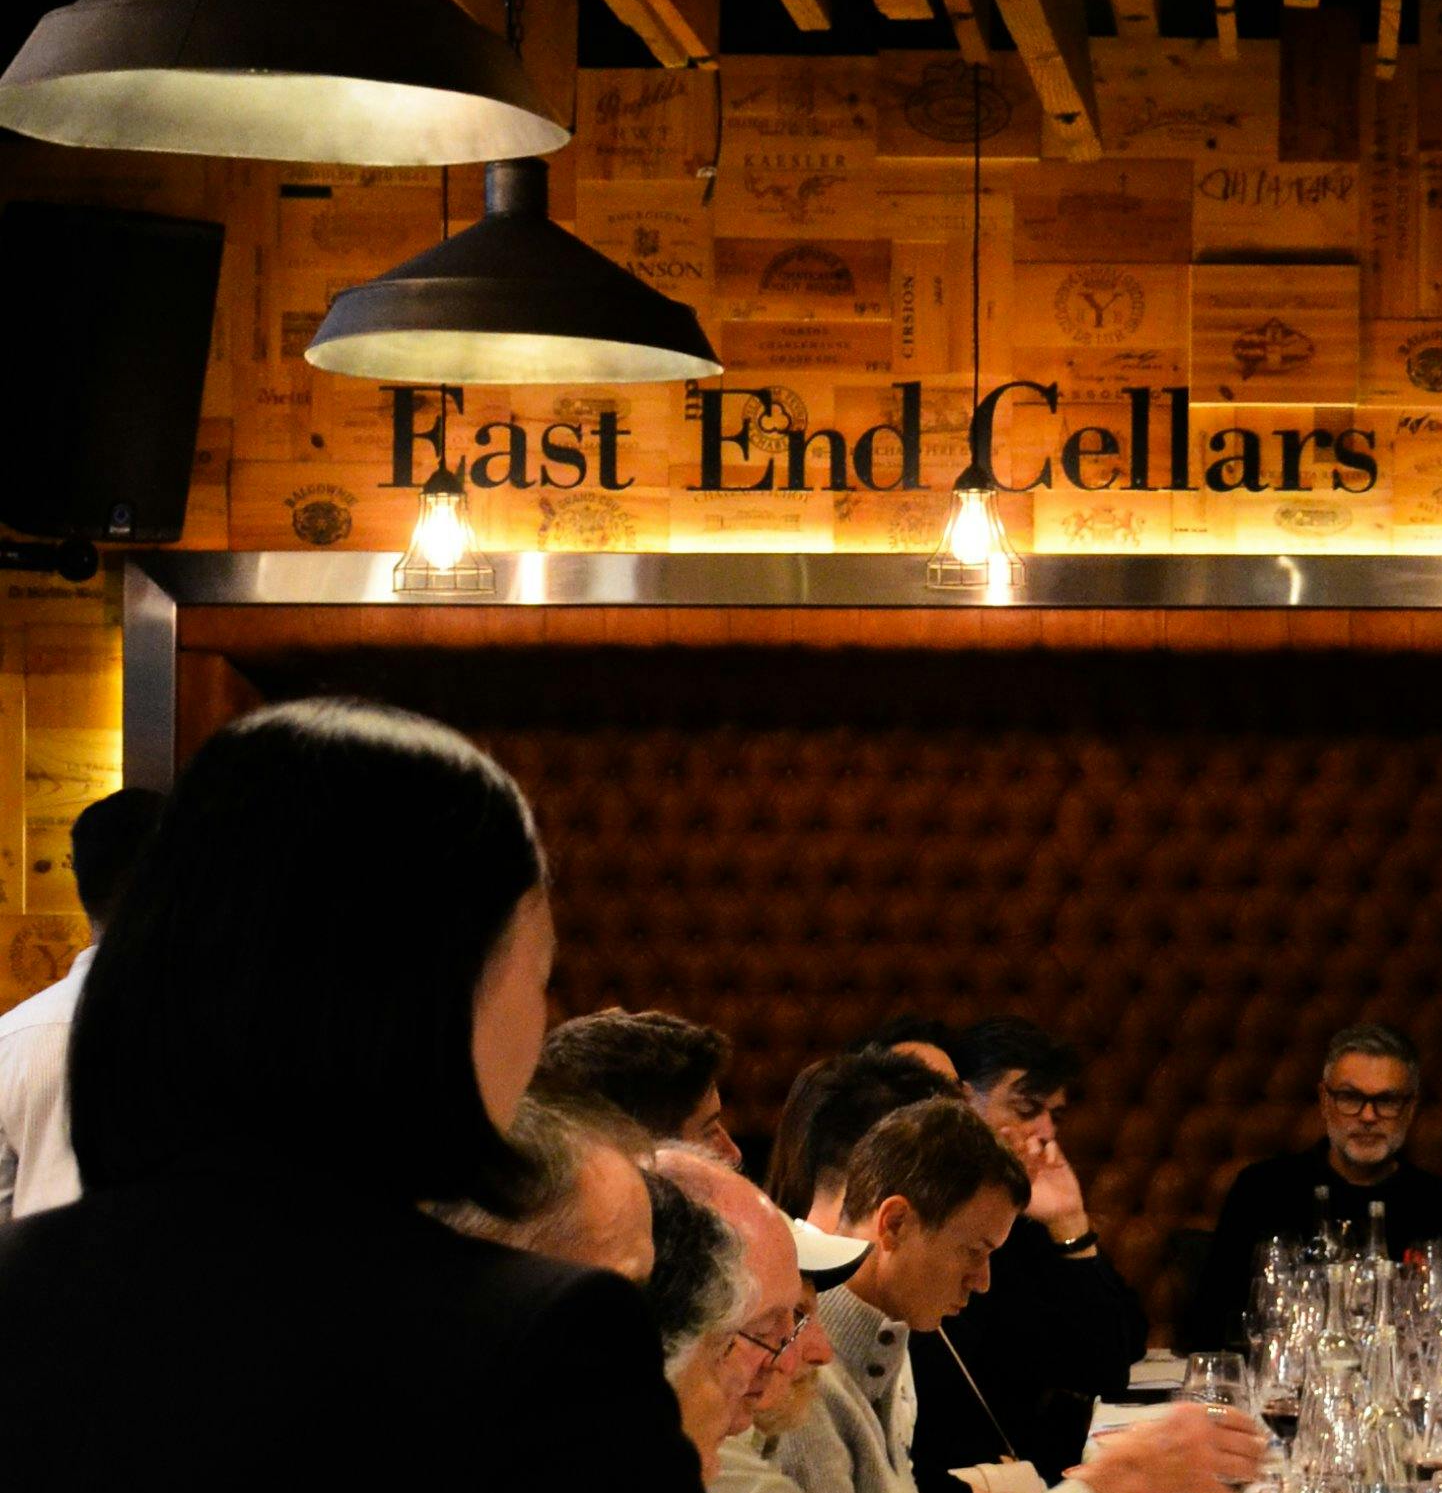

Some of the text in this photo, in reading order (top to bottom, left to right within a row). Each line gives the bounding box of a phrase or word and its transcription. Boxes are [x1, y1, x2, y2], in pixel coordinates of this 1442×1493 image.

[744, 154, 847, 168] KAESLER
[627, 260, 703, 278] ANSON
[902, 275, 915, 359] CIRSION
[378, 380, 1378, 493] East End Cellars
[283, 483, 358, 508] BALGOWNIE
